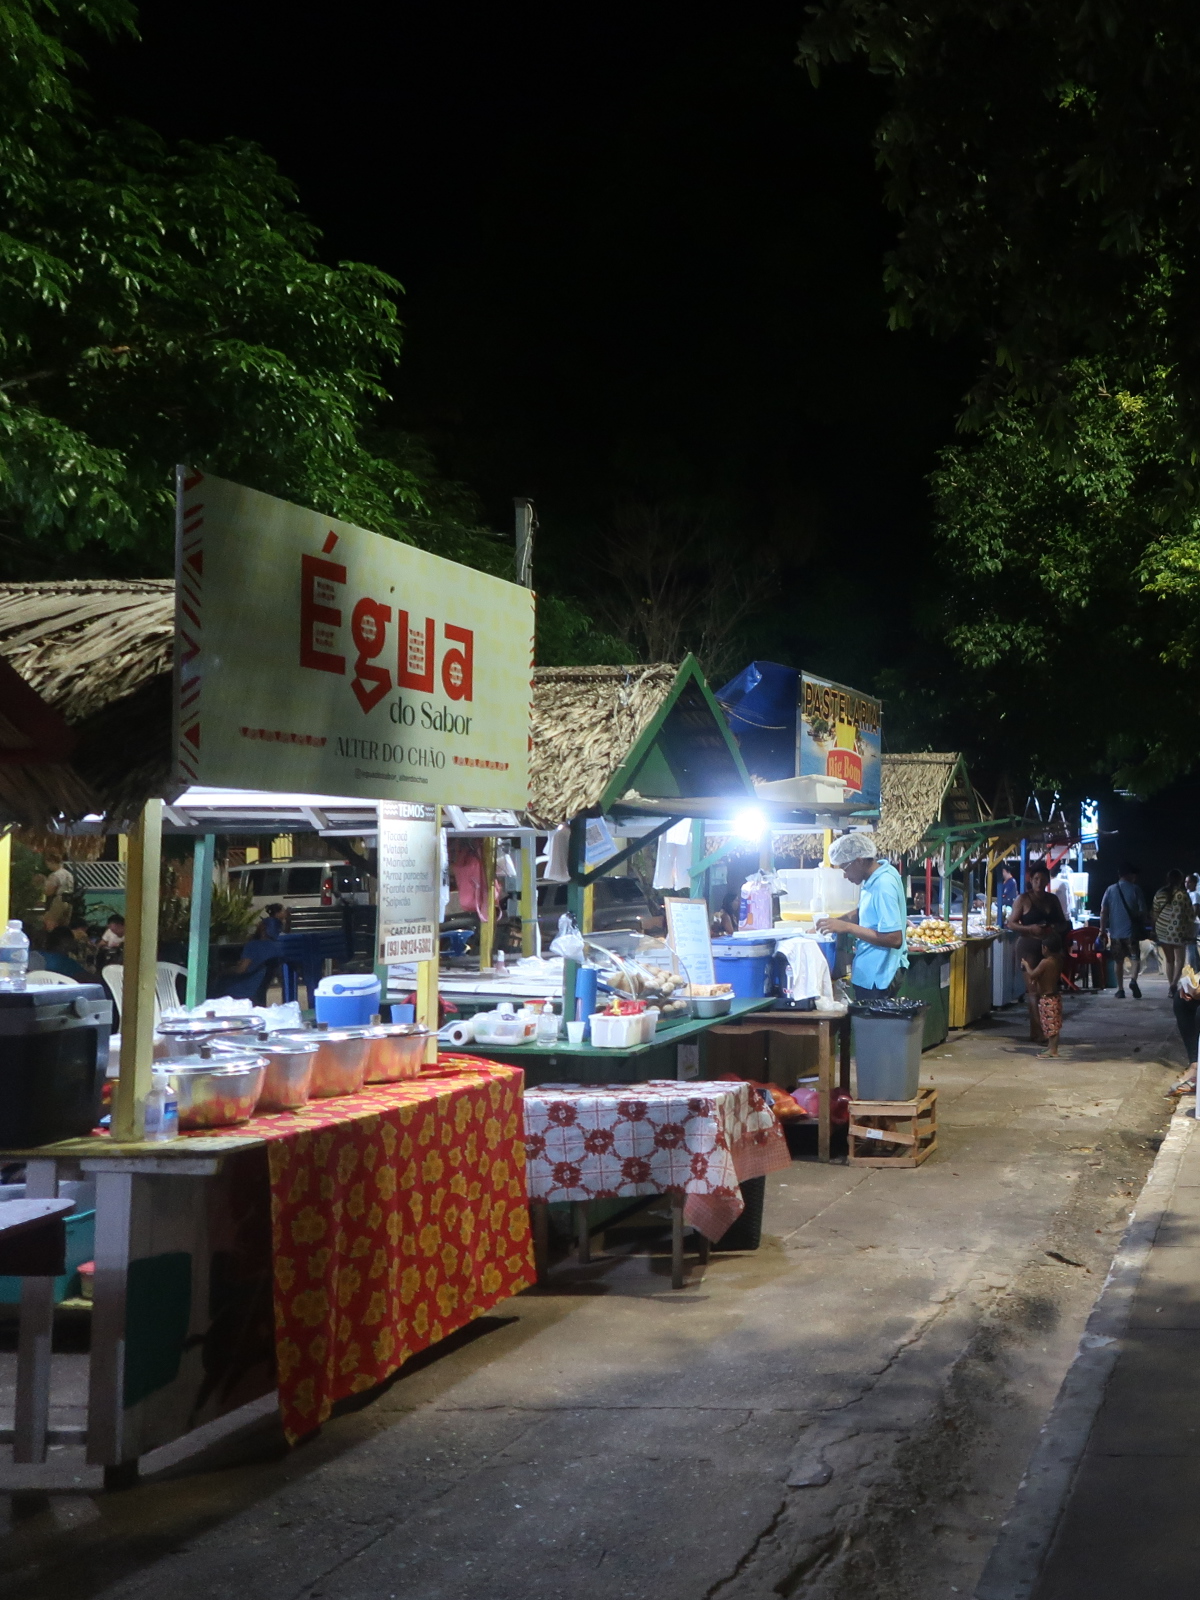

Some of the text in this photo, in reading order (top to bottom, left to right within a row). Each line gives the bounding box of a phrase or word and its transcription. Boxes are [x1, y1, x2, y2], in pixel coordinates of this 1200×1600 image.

[301, 530, 474, 714] Égua
[390, 697, 473, 735] do Sabor
[804, 682, 879, 736] PASTELARIA
[335, 736, 446, 769] ALTER DO CHÃO
[828, 756, 843, 779] Big
[398, 803, 425, 818] TEMOS
[390, 924, 416, 936] CARTÃO
[417, 924, 421, 934] E
[422, 924, 432, 933] PIX
